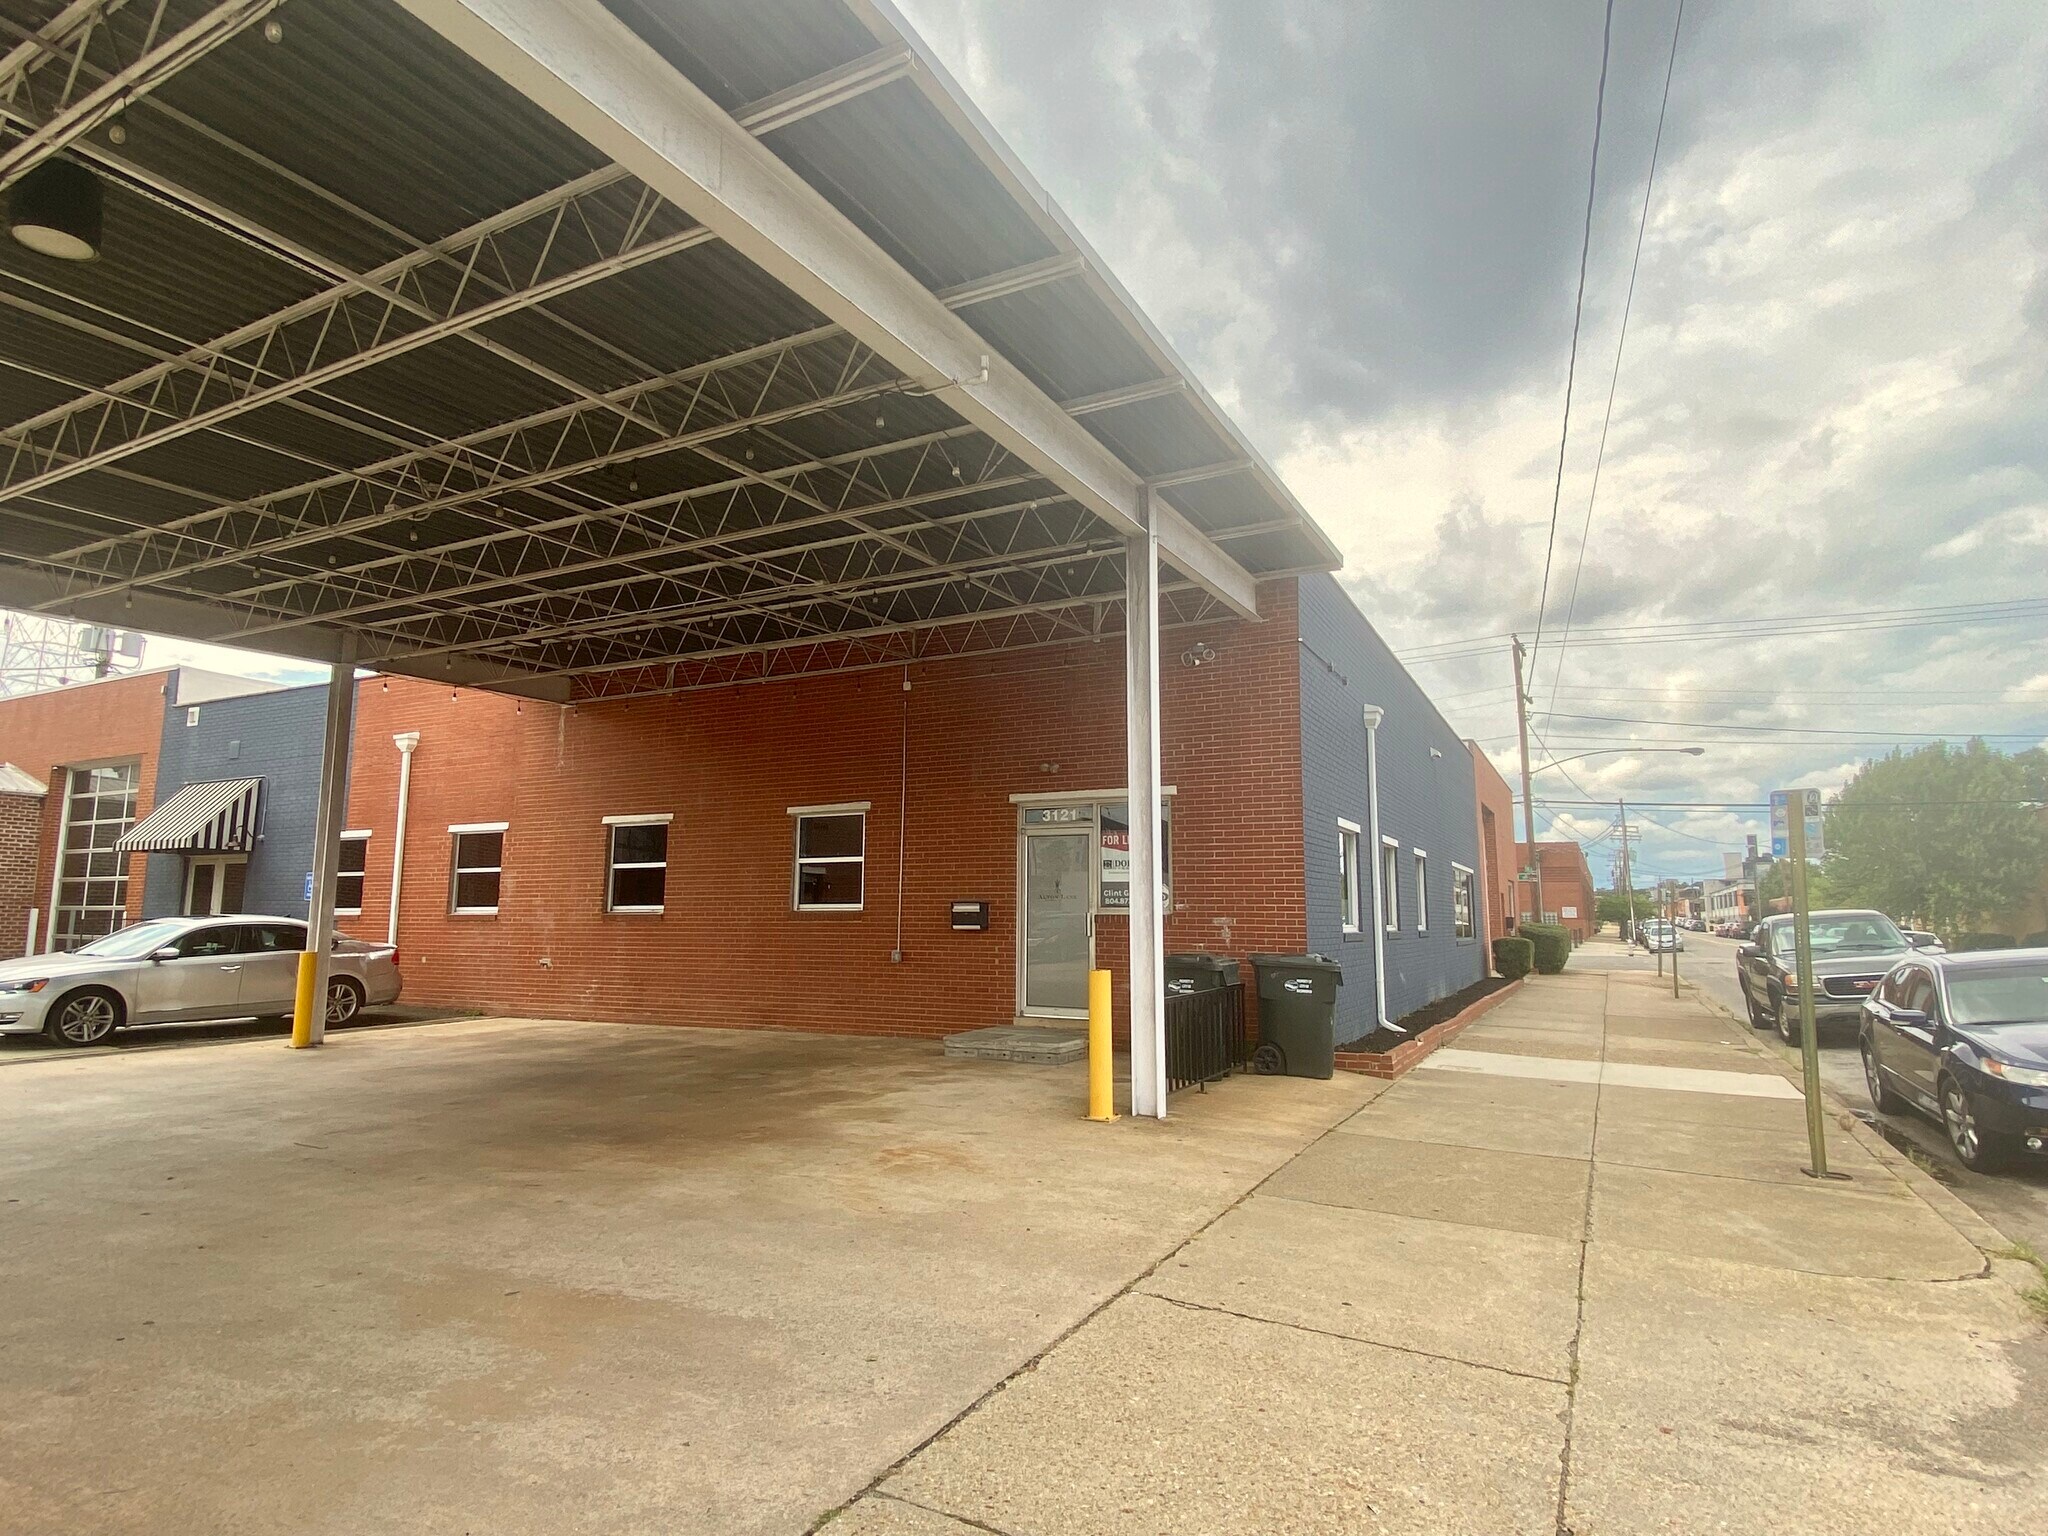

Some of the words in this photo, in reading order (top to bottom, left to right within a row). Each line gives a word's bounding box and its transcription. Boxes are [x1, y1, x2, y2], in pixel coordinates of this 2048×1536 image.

[1043, 809, 1076, 821] 3121
[1102, 835, 1119, 845] FOR
[1103, 889, 1122, 897] Clint
[1104, 897, 1129, 905] 804.87
